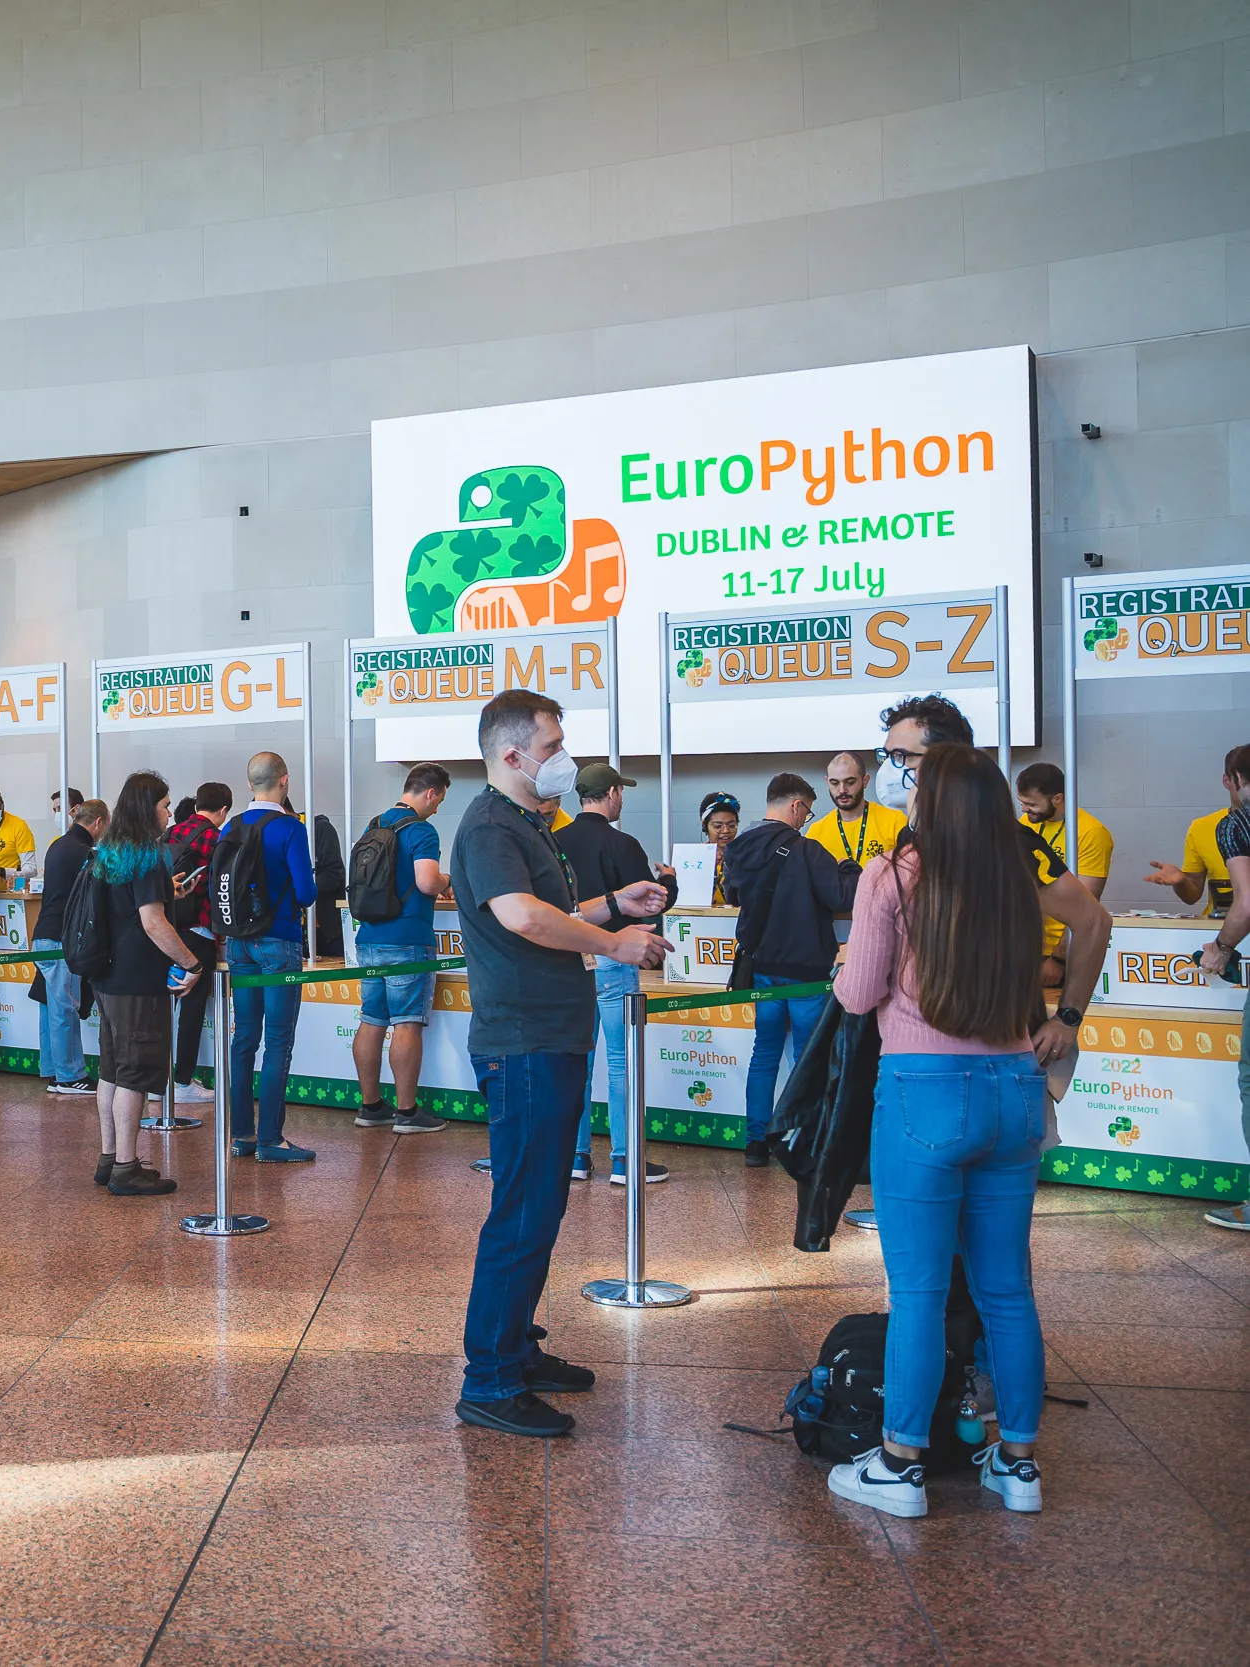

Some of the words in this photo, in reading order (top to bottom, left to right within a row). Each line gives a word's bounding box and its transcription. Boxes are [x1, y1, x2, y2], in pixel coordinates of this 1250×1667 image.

[621, 428, 994, 506] EuroPython
[656, 525, 771, 557] DUBLIN
[781, 524, 809, 548] &
[819, 511, 955, 545] REMOTE
[722, 567, 805, 598] 11-17
[814, 562, 885, 598] July
[1081, 584, 1250, 618] REGISTRAT
[674, 617, 850, 649] REGISTRATION
[865, 604, 994, 678] S-Z
[354, 645, 493, 672] REGISTRATION
[504, 642, 605, 692] M-R
[719, 641, 851, 683] QUEUE
[101, 665, 212, 690] REGISTRATION
[221, 658, 302, 712] G-L
[389, 667, 493, 703] QUEUE
[129, 684, 213, 718] QUEUE
[218, 873, 232, 925] adidas
[682, 1028, 713, 1043] 2022
[660, 1048, 737, 1066] EuroPython
[671, 1068, 694, 1076] DUBLIN
[1101, 1057, 1142, 1074] 2022
[1073, 1079, 1173, 1101] EuroPython
[1087, 1101, 1116, 1111] DUBLIN
[1127, 1105, 1159, 1115] REMOTE
